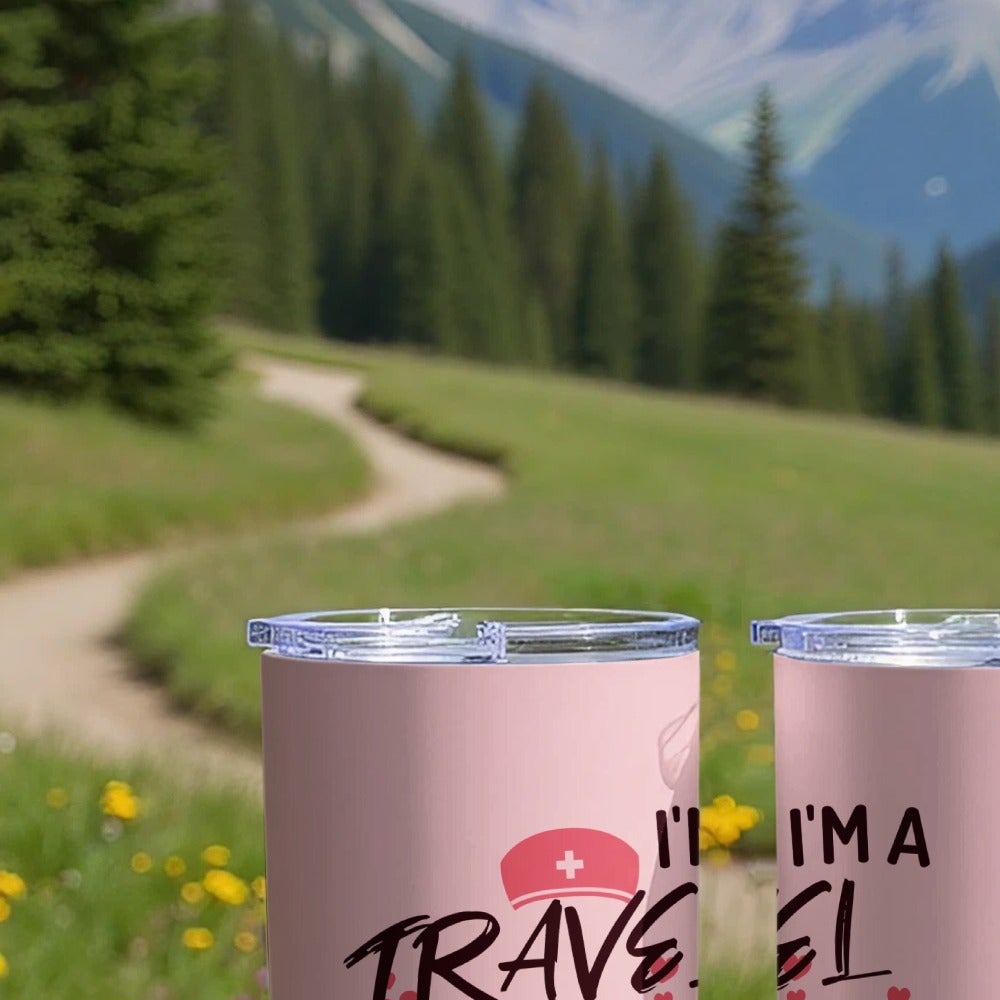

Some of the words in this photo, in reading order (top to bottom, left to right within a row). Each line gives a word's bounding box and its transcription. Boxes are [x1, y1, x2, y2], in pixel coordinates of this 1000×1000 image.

[655, 805, 699, 869] I'
[789, 804, 869, 867] I'M
[886, 806, 931, 868] A
